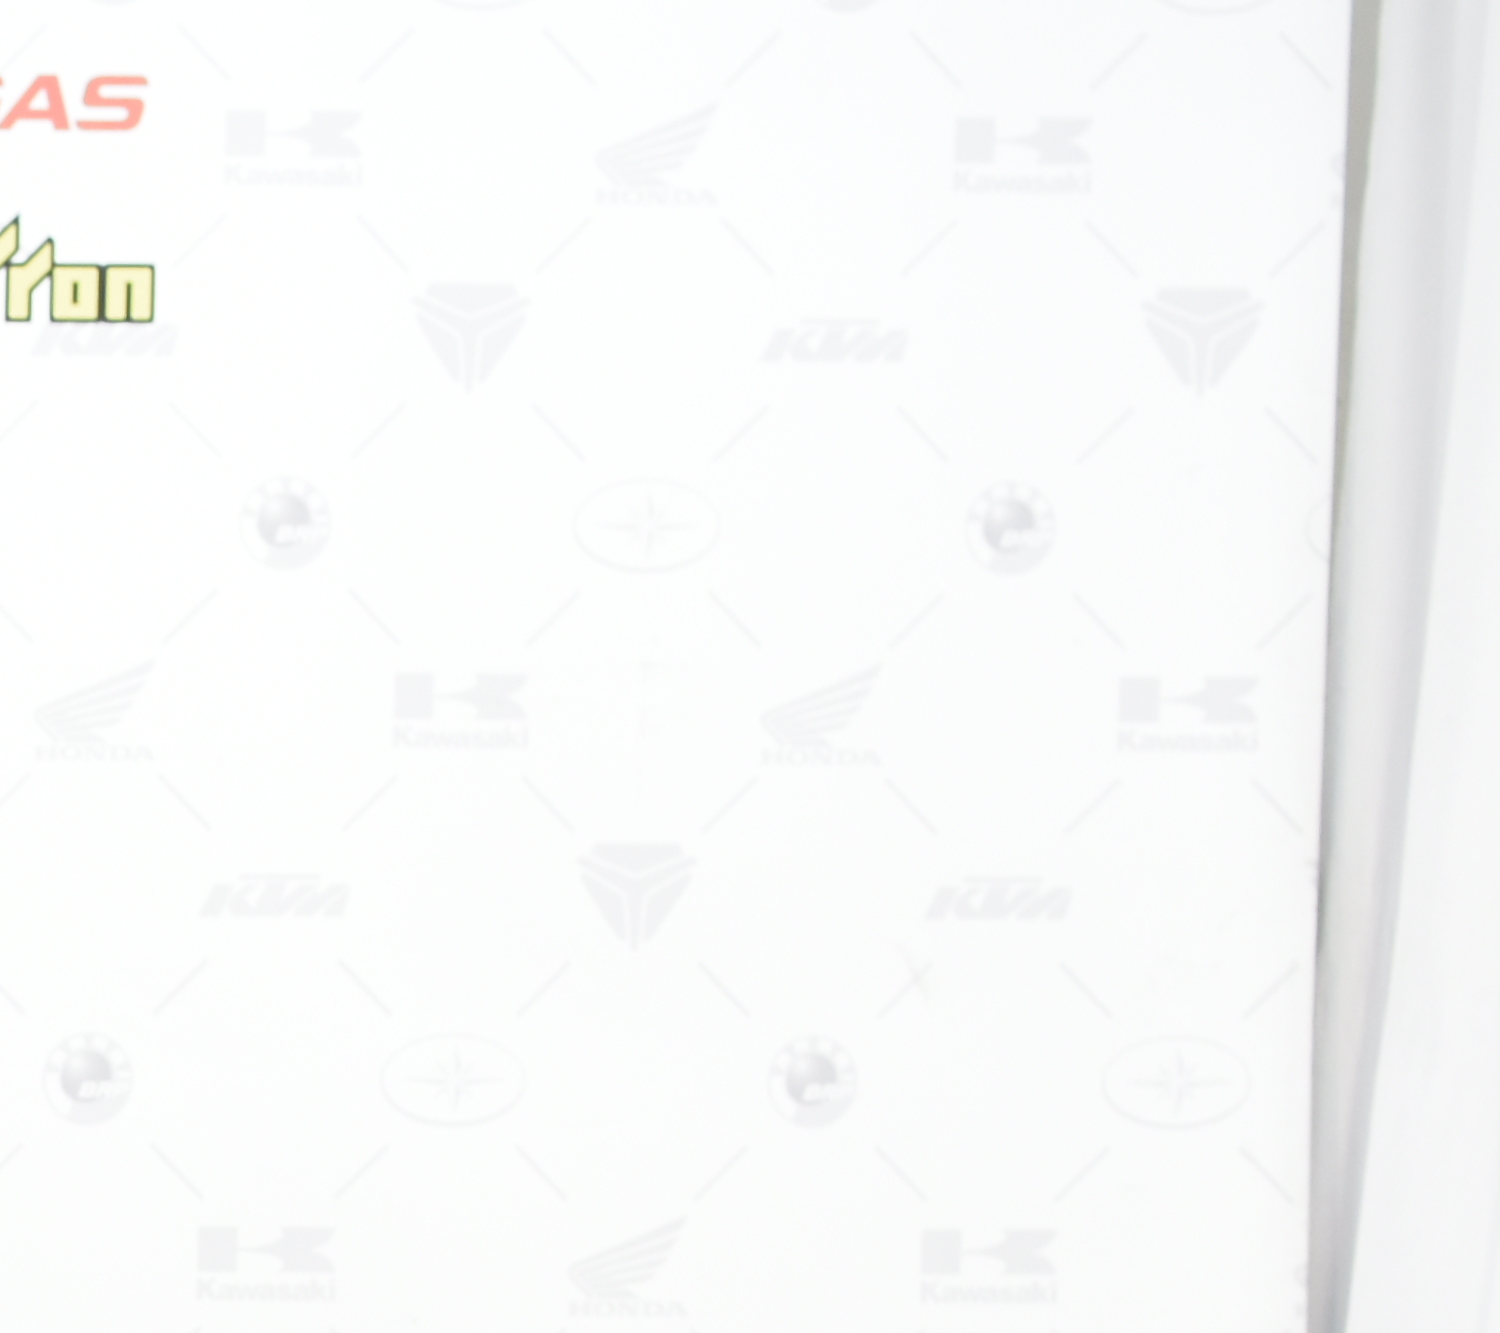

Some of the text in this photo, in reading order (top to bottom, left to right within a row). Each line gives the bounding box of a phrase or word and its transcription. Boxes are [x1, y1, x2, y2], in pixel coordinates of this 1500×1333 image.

[760, 318, 907, 364] KTM
[197, 872, 350, 919] KTM
[924, 875, 1072, 921] KTM
